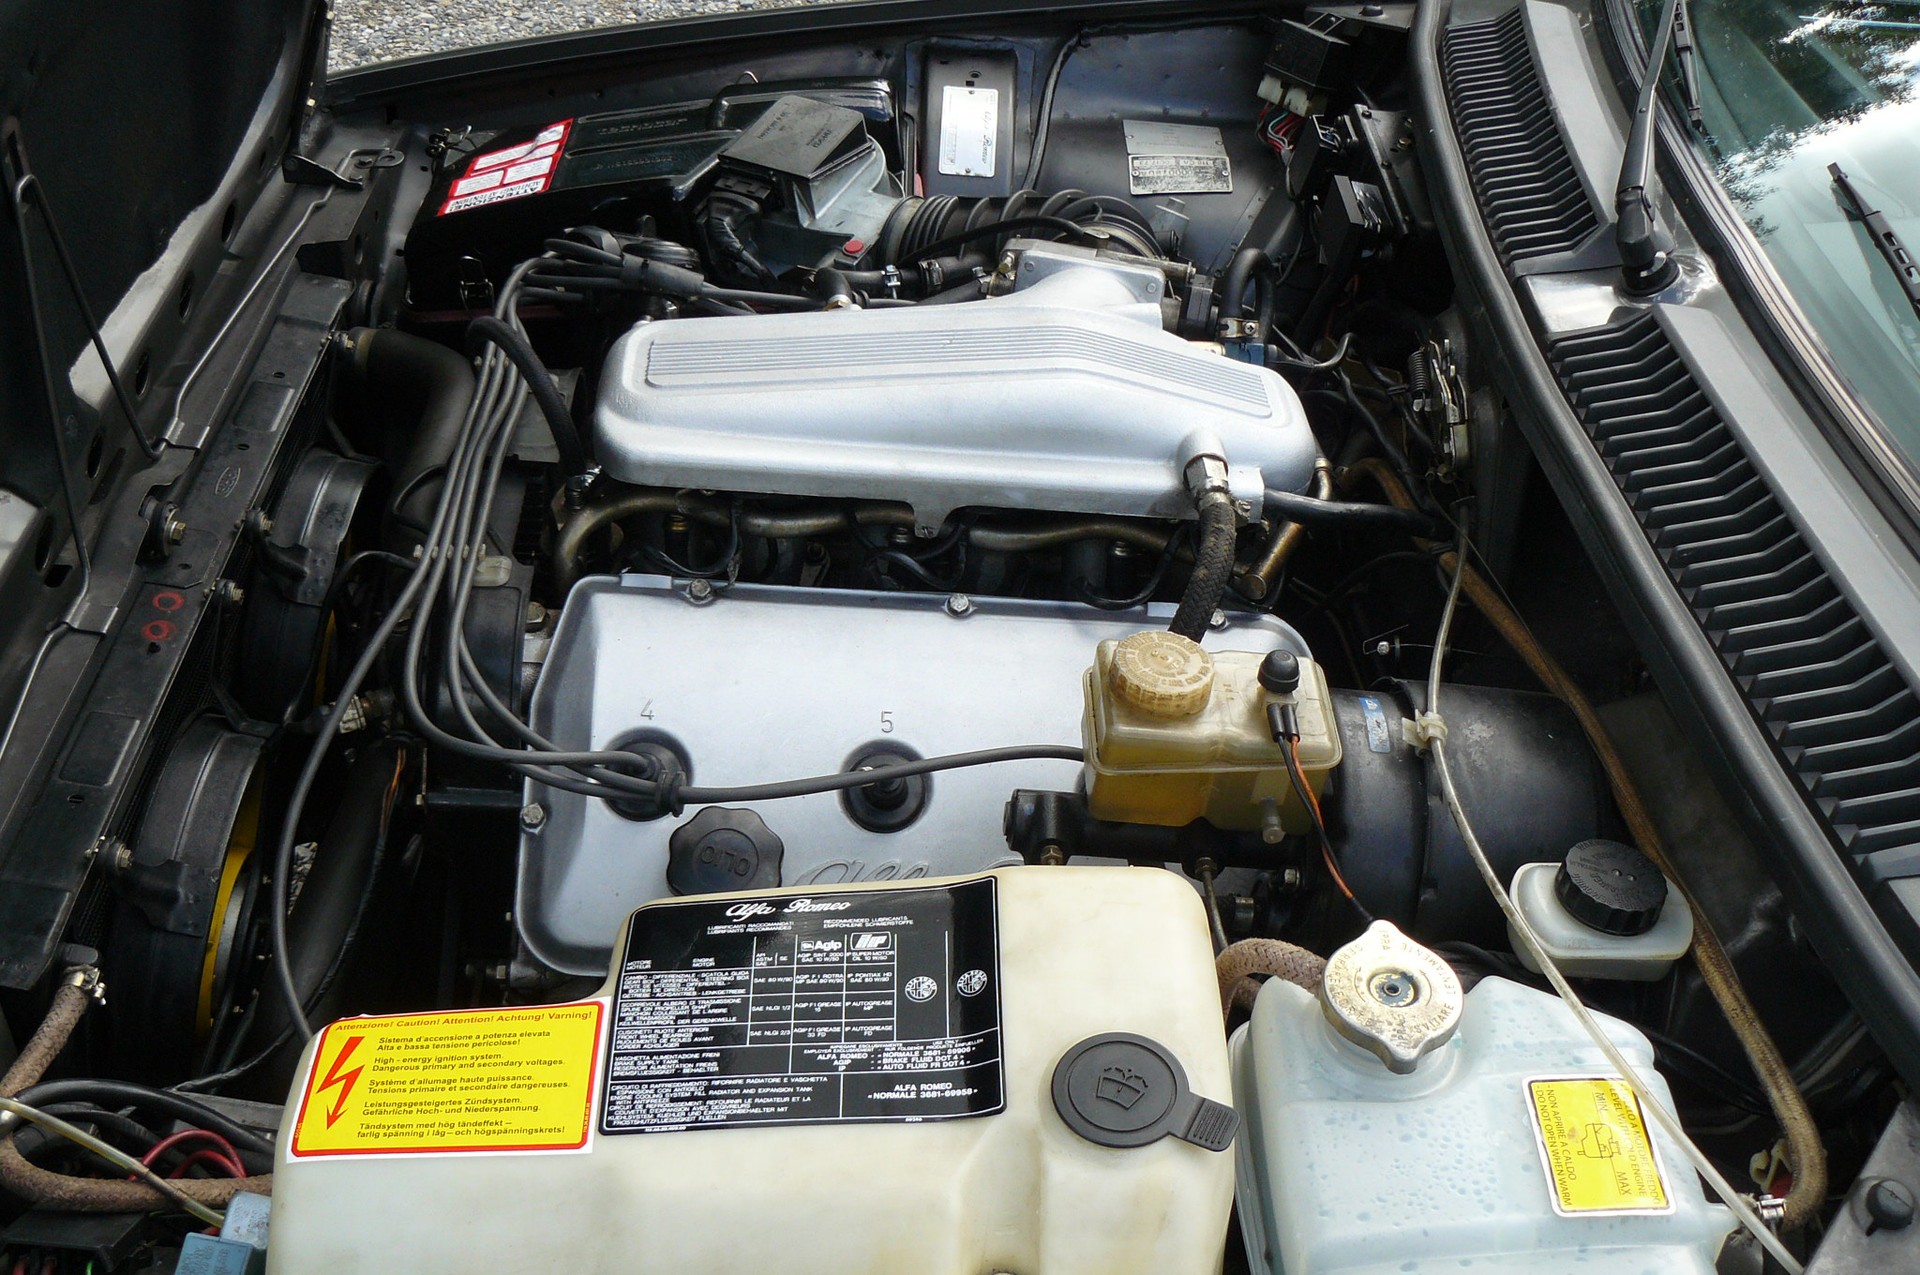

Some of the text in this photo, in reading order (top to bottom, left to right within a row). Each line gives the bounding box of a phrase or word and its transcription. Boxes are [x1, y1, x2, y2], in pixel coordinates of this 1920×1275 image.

[449, 187, 538, 211] ATTENZIONE!
[640, 698, 655, 721] 4
[880, 710, 894, 733] 5
[725, 899, 851, 921] Alfa Romeo
[814, 940, 842, 950] Agip
[336, 1011, 592, 1031] Attenzione! Caution! Attention! Achtung! Varning!
[377, 1043, 395, 1051] Alta
[404, 1041, 430, 1050] bassa
[432, 1040, 470, 1049] tensione
[471, 1039, 521, 1049] pericolose!
[379, 1036, 414, 1044] Sistema
[482, 1032, 518, 1041] potenza
[519, 1030, 551, 1038] elevata
[372, 1058, 565, 1072] Dangerous primary and secondary voltages.
[374, 1053, 503, 1066] High energy ignition system.
[368, 1086, 407, 1094] Tensions
[409, 1086, 446, 1095] primaire
[459, 1082, 507, 1091] secondaire
[510, 1081, 569, 1091] dangereuses.
[369, 1079, 407, 1088] Système
[487, 1074, 535, 1083] puissance.
[920, 1082, 952, 1090] ROMEO
[364, 1099, 462, 1109] Leistungsgesteigertes
[1547, 1089, 1558, 1108] NON
[1595, 1092, 1608, 1111] MIN
[362, 1103, 541, 1116] Gefährliche Hoch- und Niederspannung.
[357, 1130, 380, 1139] farlig
[383, 1129, 424, 1138] spänning
[455, 1128, 471, 1136] och
[474, 1126, 565, 1137] högspänningskrets!
[360, 1121, 413, 1131] Tändsystem
[416, 1121, 435, 1129] med
[1552, 1110, 1566, 1139] APRIRE
[1536, 1089, 1572, 1206] DO NOT OPEN WHEN WARM
[1609, 1088, 1622, 1112] LEVEL
[1631, 1163, 1647, 1197] ENGINE
[1562, 1149, 1577, 1181] CALDO
[1616, 1171, 1632, 1196] MAX
